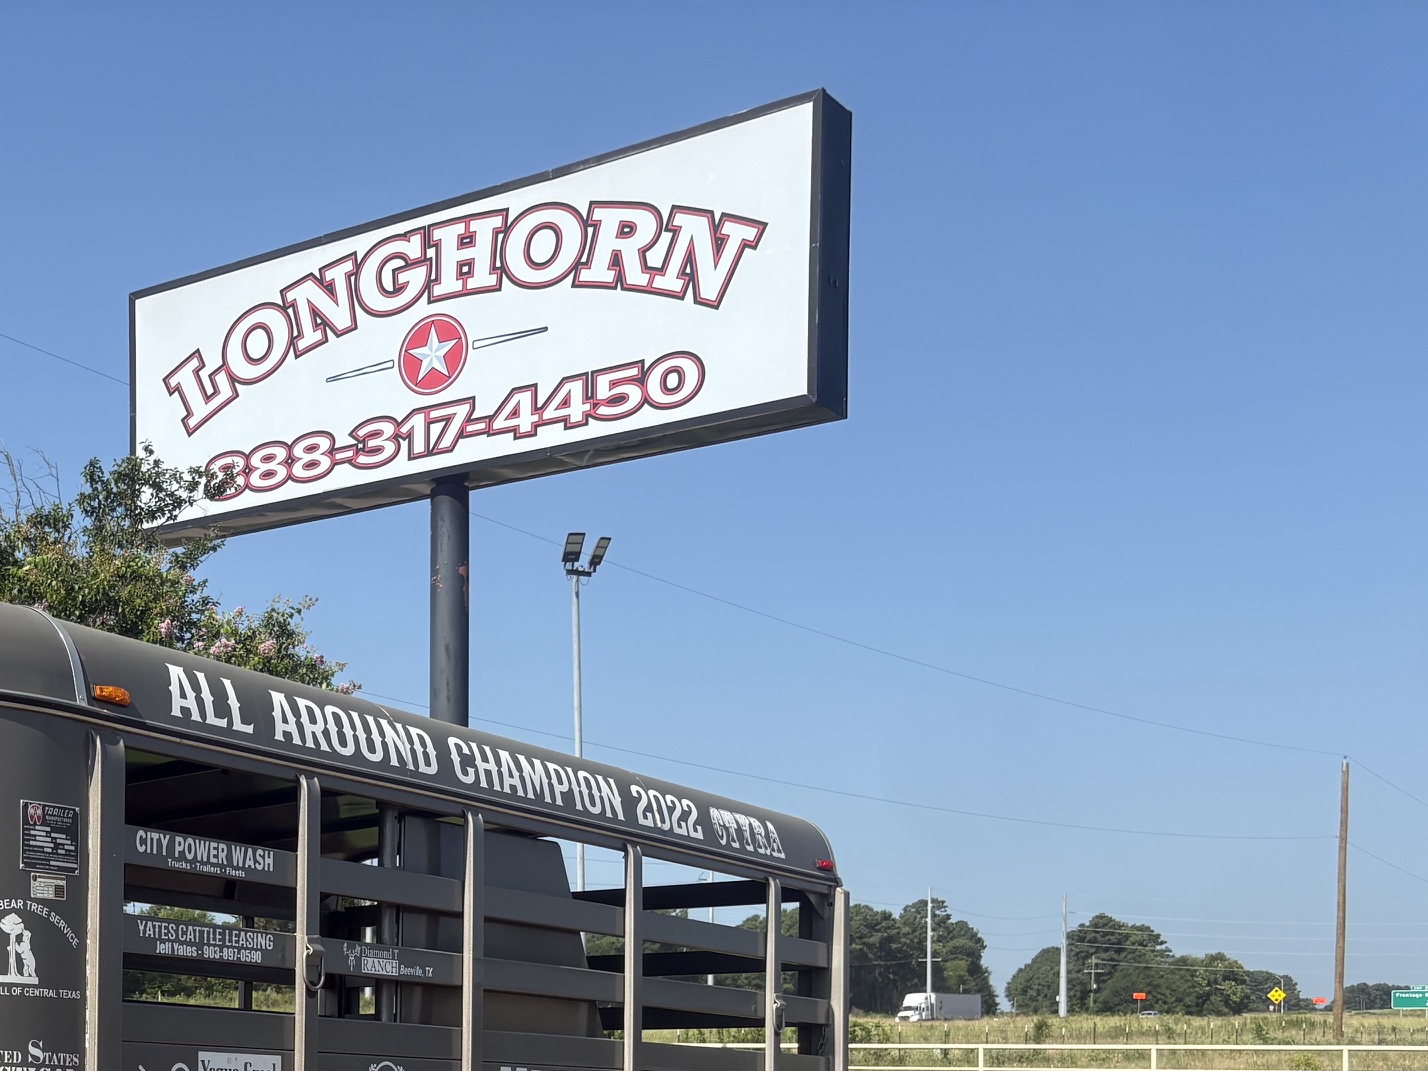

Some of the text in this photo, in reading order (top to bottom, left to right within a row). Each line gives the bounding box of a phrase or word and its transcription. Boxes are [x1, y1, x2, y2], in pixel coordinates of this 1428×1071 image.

[164, 200, 769, 436] LONGHORN
[204, 350, 706, 500] 888-317-4450
[164, 663, 786, 859] ALL AROUND CHAMPION 2022 CTYRA
[44, 806, 74, 819] TRAILER
[136, 829, 274, 871] CITY POWER WASH
[167, 858, 246, 878] Trucks Trailers Fleets
[26, 900, 50, 919] TREE
[49, 912, 80, 949] SERVICE
[137, 919, 274, 950] YATES CATTLE LEASING
[156, 941, 173, 955] Jeff
[173, 942, 197, 957] Yates
[203, 945, 262, 963] 903-897-0590
[361, 945, 400, 960] Diamond T
[362, 958, 399, 975] RANCH
[425, 966, 433, 978] TX
[11, 987, 23, 996] OF
[24, 988, 58, 999] CENTRAL
[59, 989, 81, 1000] TEXAS
